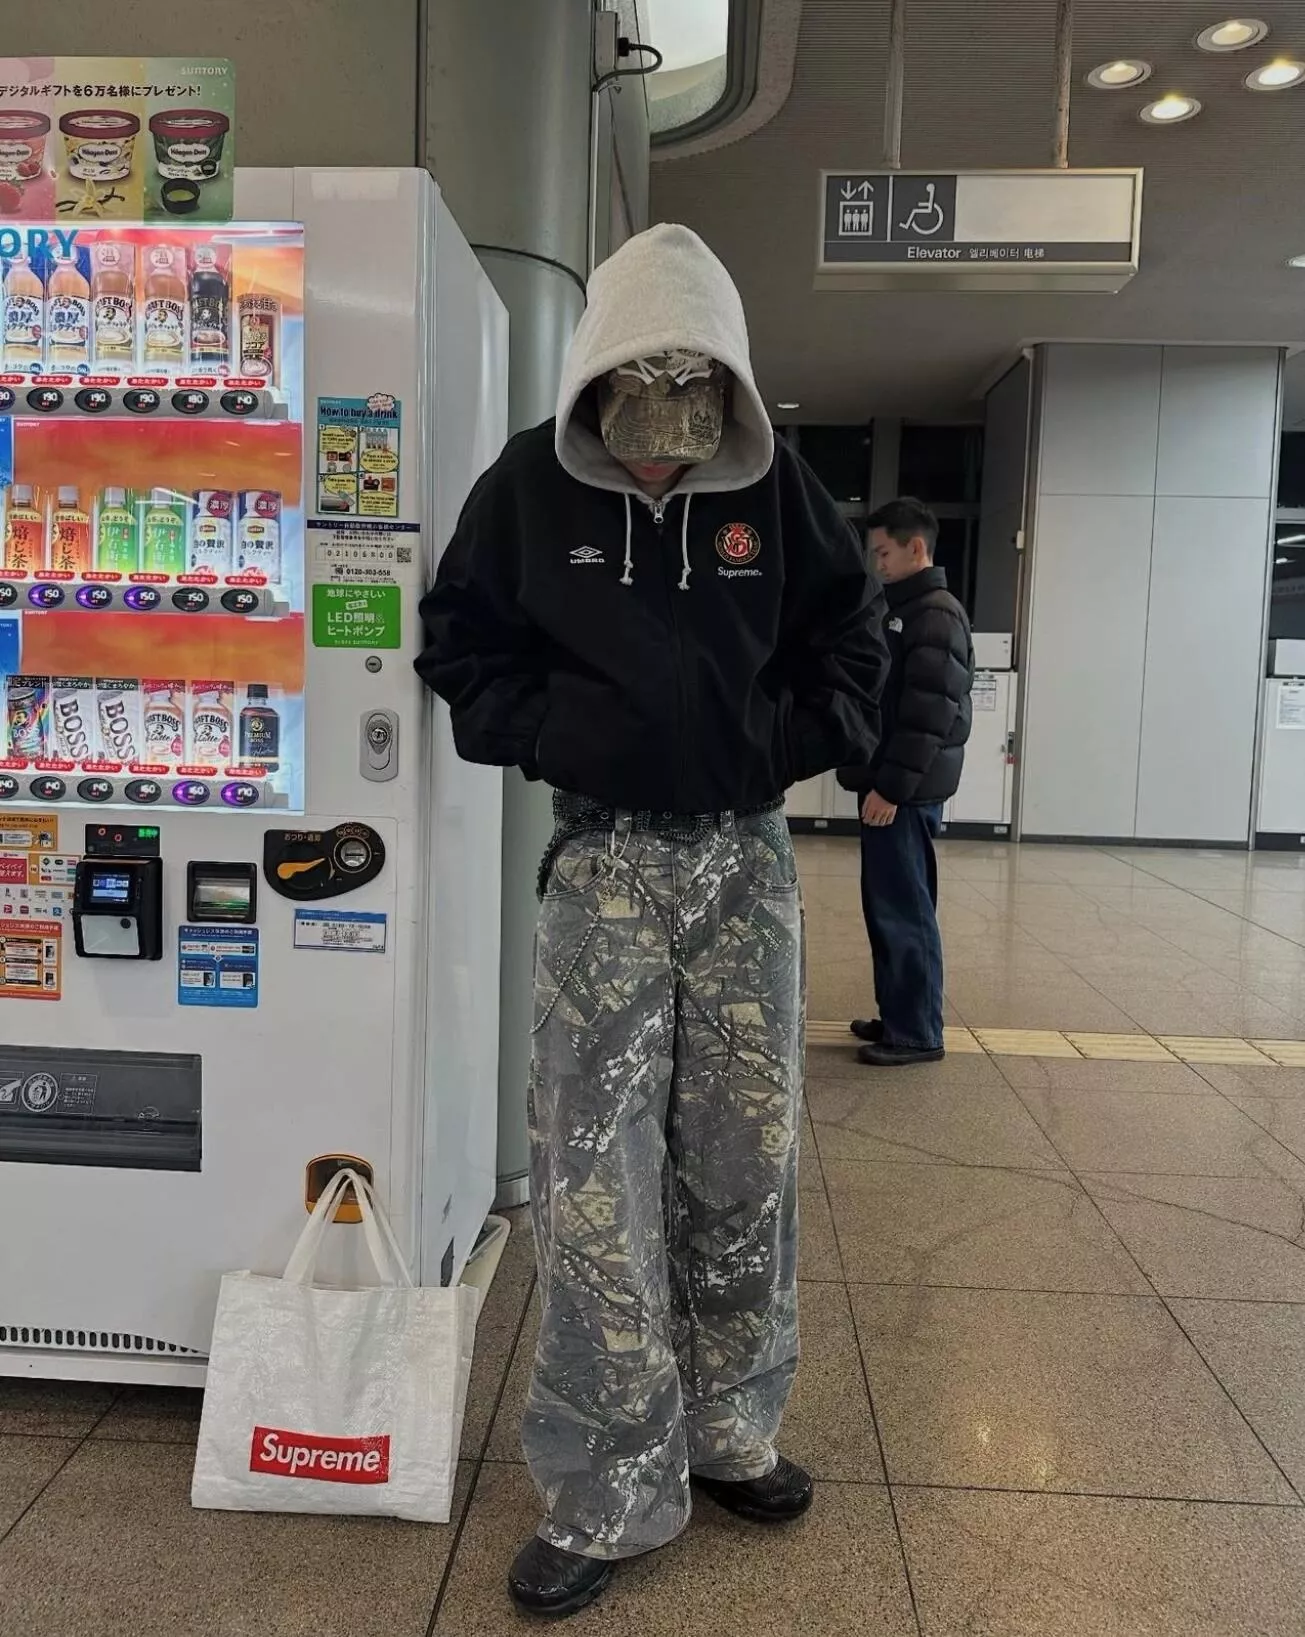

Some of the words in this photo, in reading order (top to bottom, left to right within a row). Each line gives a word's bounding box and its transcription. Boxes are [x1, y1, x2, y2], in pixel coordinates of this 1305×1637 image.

[181, 67, 228, 75] SUNTORY
[907, 246, 961, 259] Elevator
[969, 247, 1019, 259] 엘리베이터
[327, 588, 387, 599] 地球にやさしい
[327, 625, 386, 637] ヒートポンプ
[60, 698, 89, 758] BOSS
[105, 700, 136, 760] BOSS
[259, 1432, 381, 1474] Supreme
